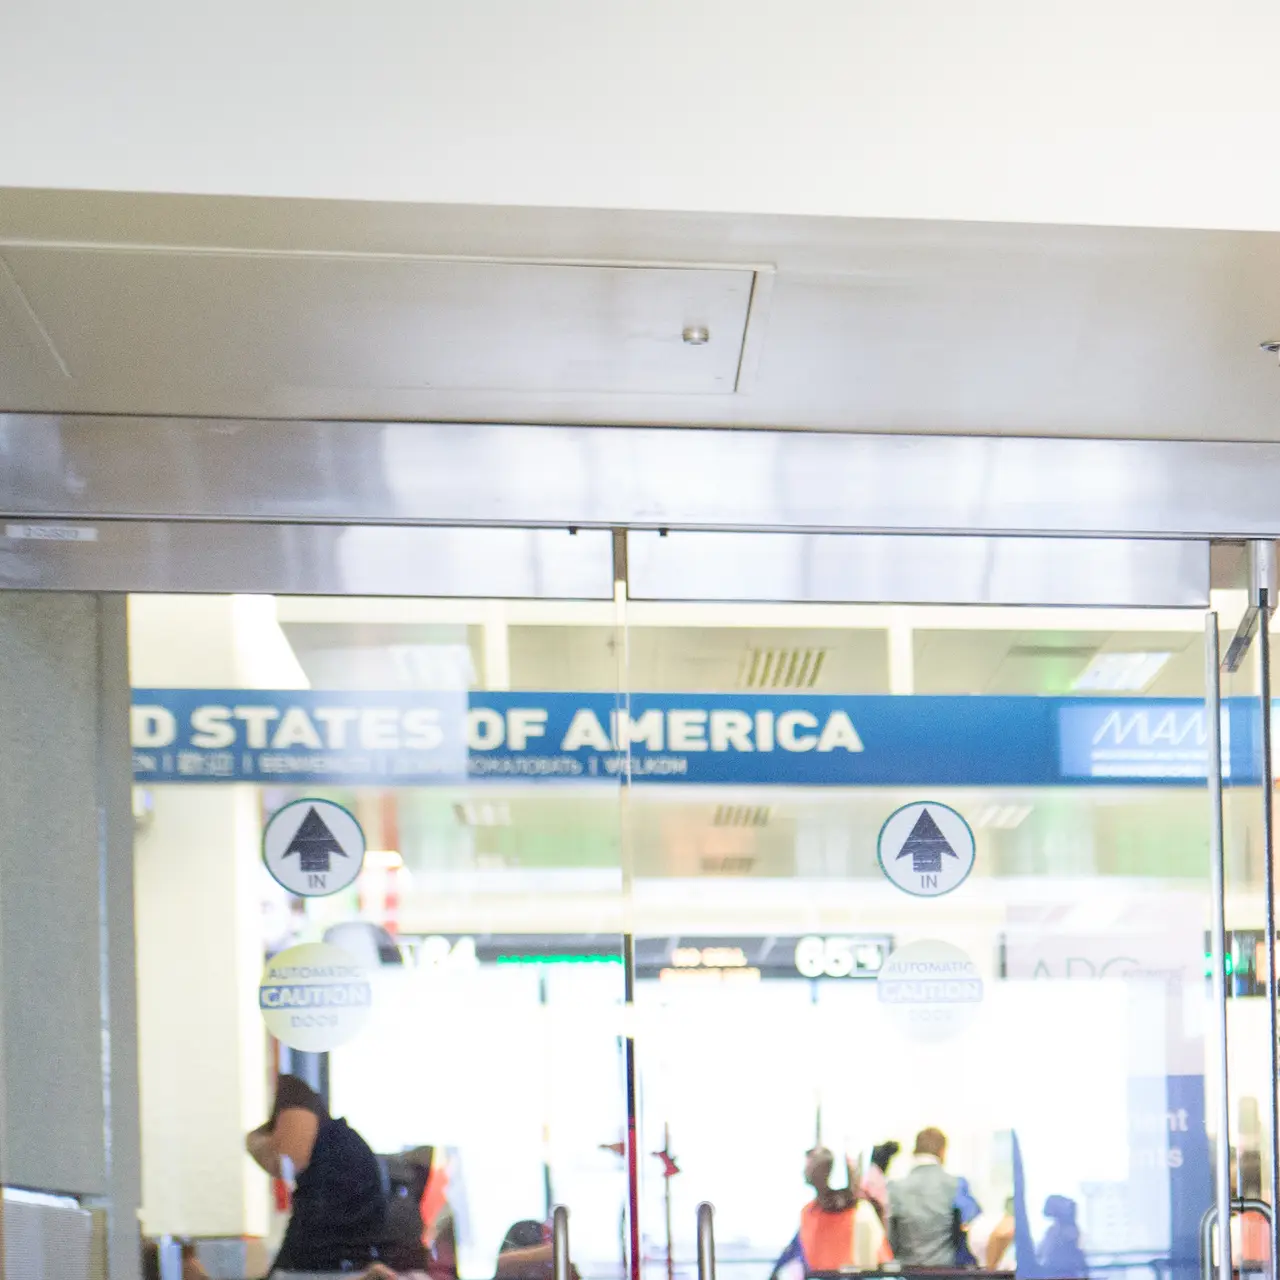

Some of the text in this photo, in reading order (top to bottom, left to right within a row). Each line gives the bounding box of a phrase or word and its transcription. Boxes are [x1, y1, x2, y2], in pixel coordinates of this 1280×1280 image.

[190, 705, 444, 750] STATES
[466, 707, 548, 750] OF
[562, 710, 865, 752] AMERICA
[307, 874, 327, 889] IN
[920, 874, 938, 889] IN
[268, 966, 362, 980] AUTOMATIC
[887, 961, 973, 974] AUTOMATIC
[263, 986, 368, 1007] CAUTION
[883, 981, 980, 1000] CAUTION
